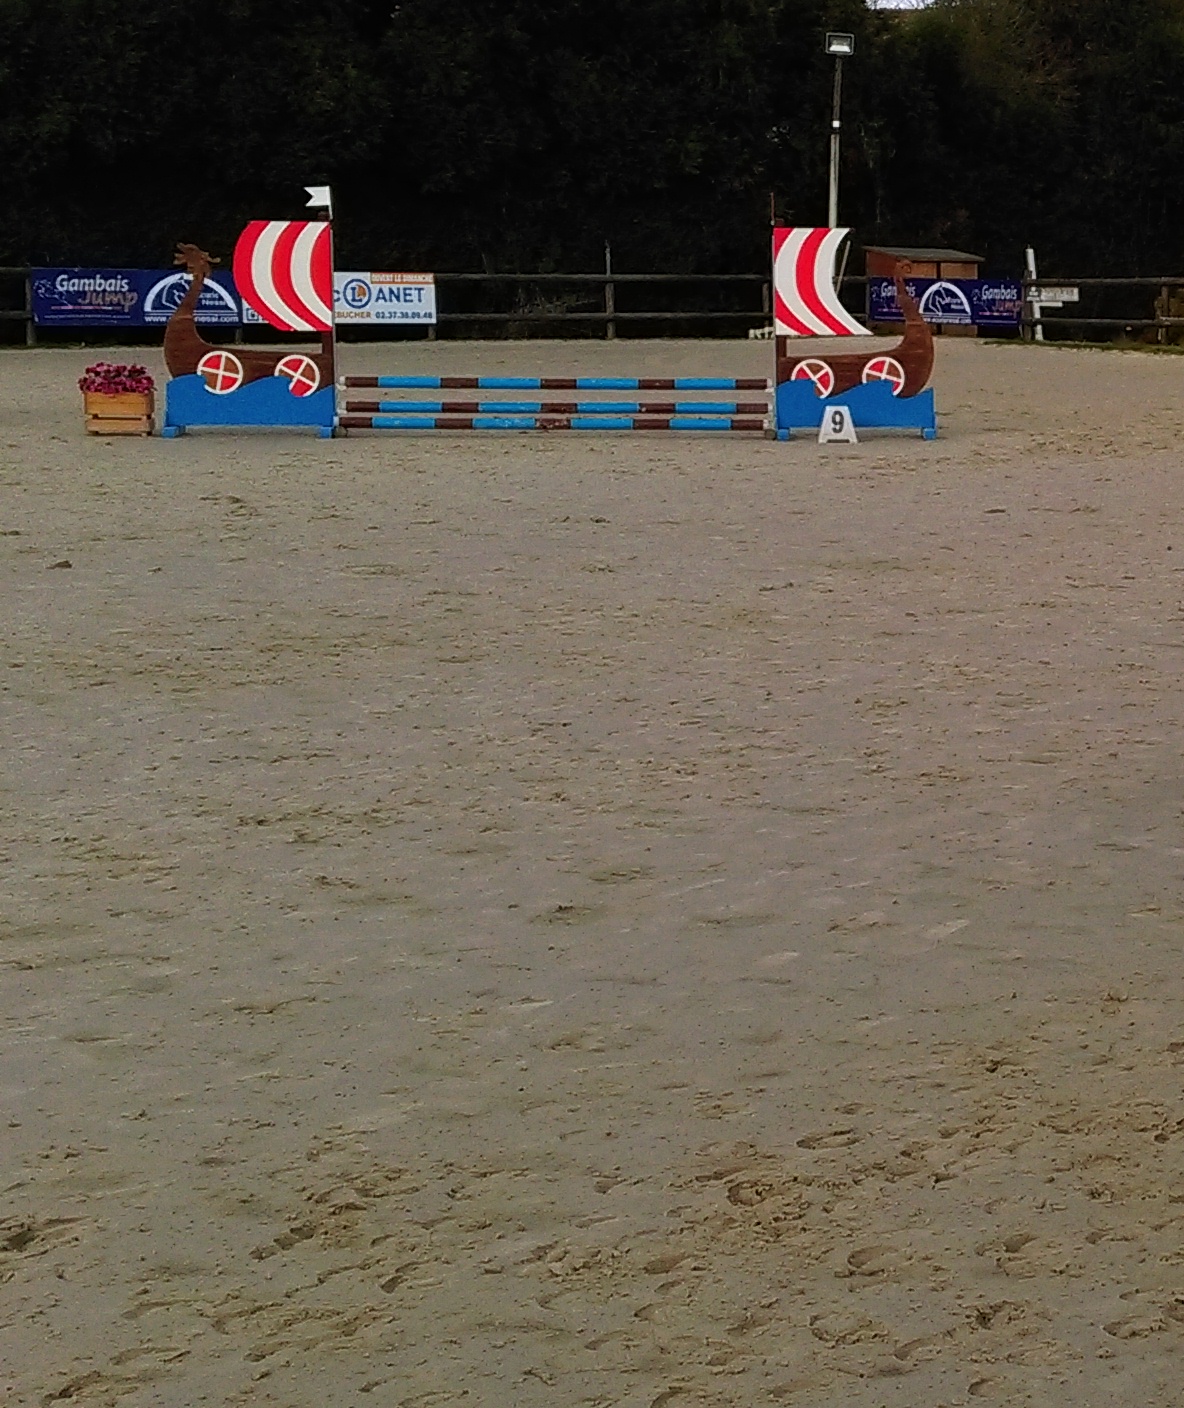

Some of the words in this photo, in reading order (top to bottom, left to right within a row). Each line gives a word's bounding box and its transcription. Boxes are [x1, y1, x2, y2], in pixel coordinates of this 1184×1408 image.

[55, 274, 129, 292] Gambais
[375, 286, 425, 303] ANET
[981, 284, 1018, 300] Gambais
[831, 410, 845, 434] 9
